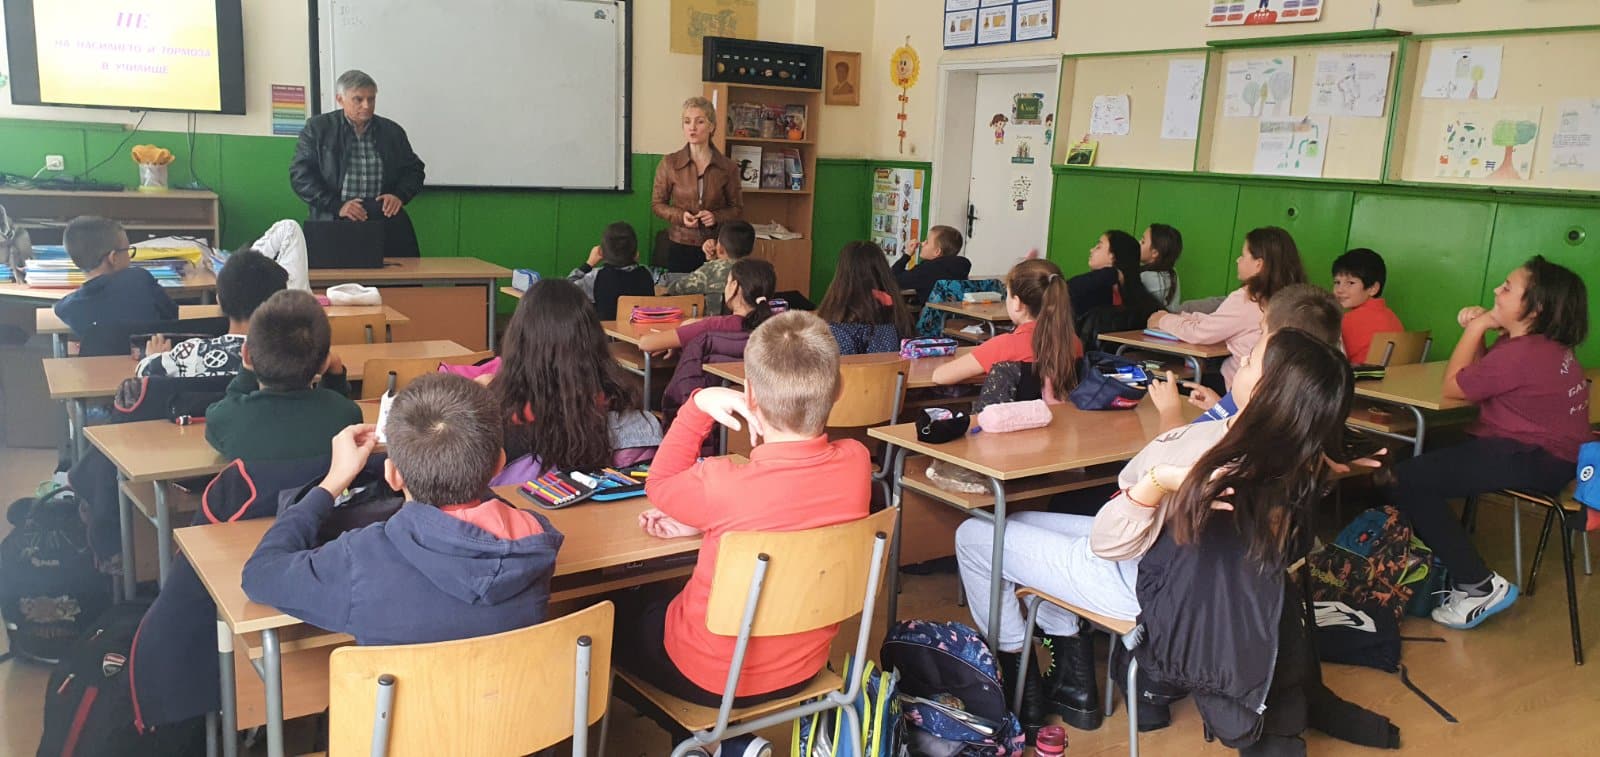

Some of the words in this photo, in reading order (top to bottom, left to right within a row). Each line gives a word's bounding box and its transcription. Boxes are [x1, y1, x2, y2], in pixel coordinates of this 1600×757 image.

[115, 11, 151, 29] НЕ
[54, 39, 70, 48] НА
[76, 40, 142, 53] НАСИЛИЕТО
[160, 46, 211, 57] ТОРМОЗА
[101, 62, 109, 70] В
[115, 63, 169, 74] УЧИЛИЩЕ
